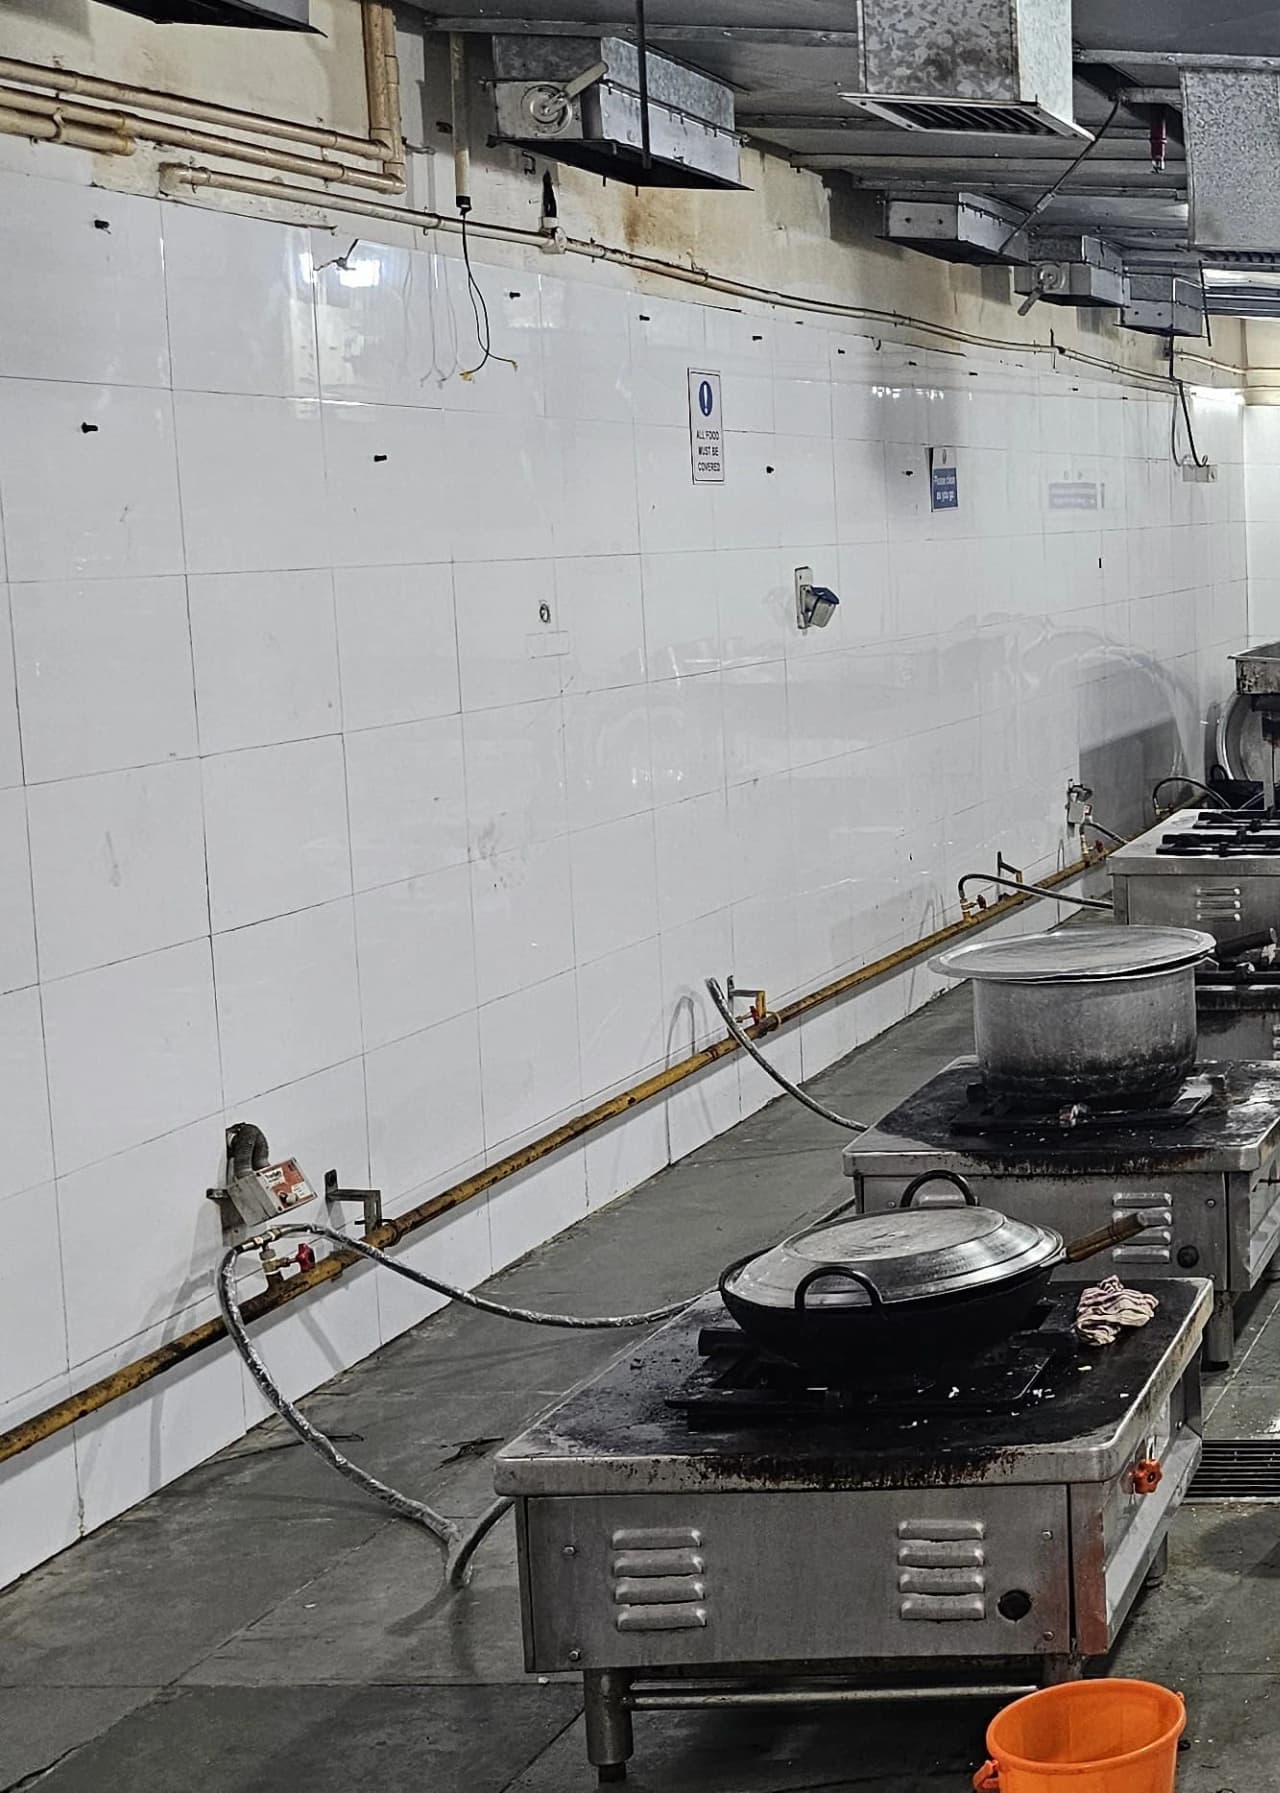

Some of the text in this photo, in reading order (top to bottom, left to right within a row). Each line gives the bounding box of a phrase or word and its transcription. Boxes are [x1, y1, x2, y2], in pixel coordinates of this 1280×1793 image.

[696, 430, 720, 440] ALL FOOD
[698, 446, 719, 456] MUST BE
[698, 462, 720, 472] COVERED
